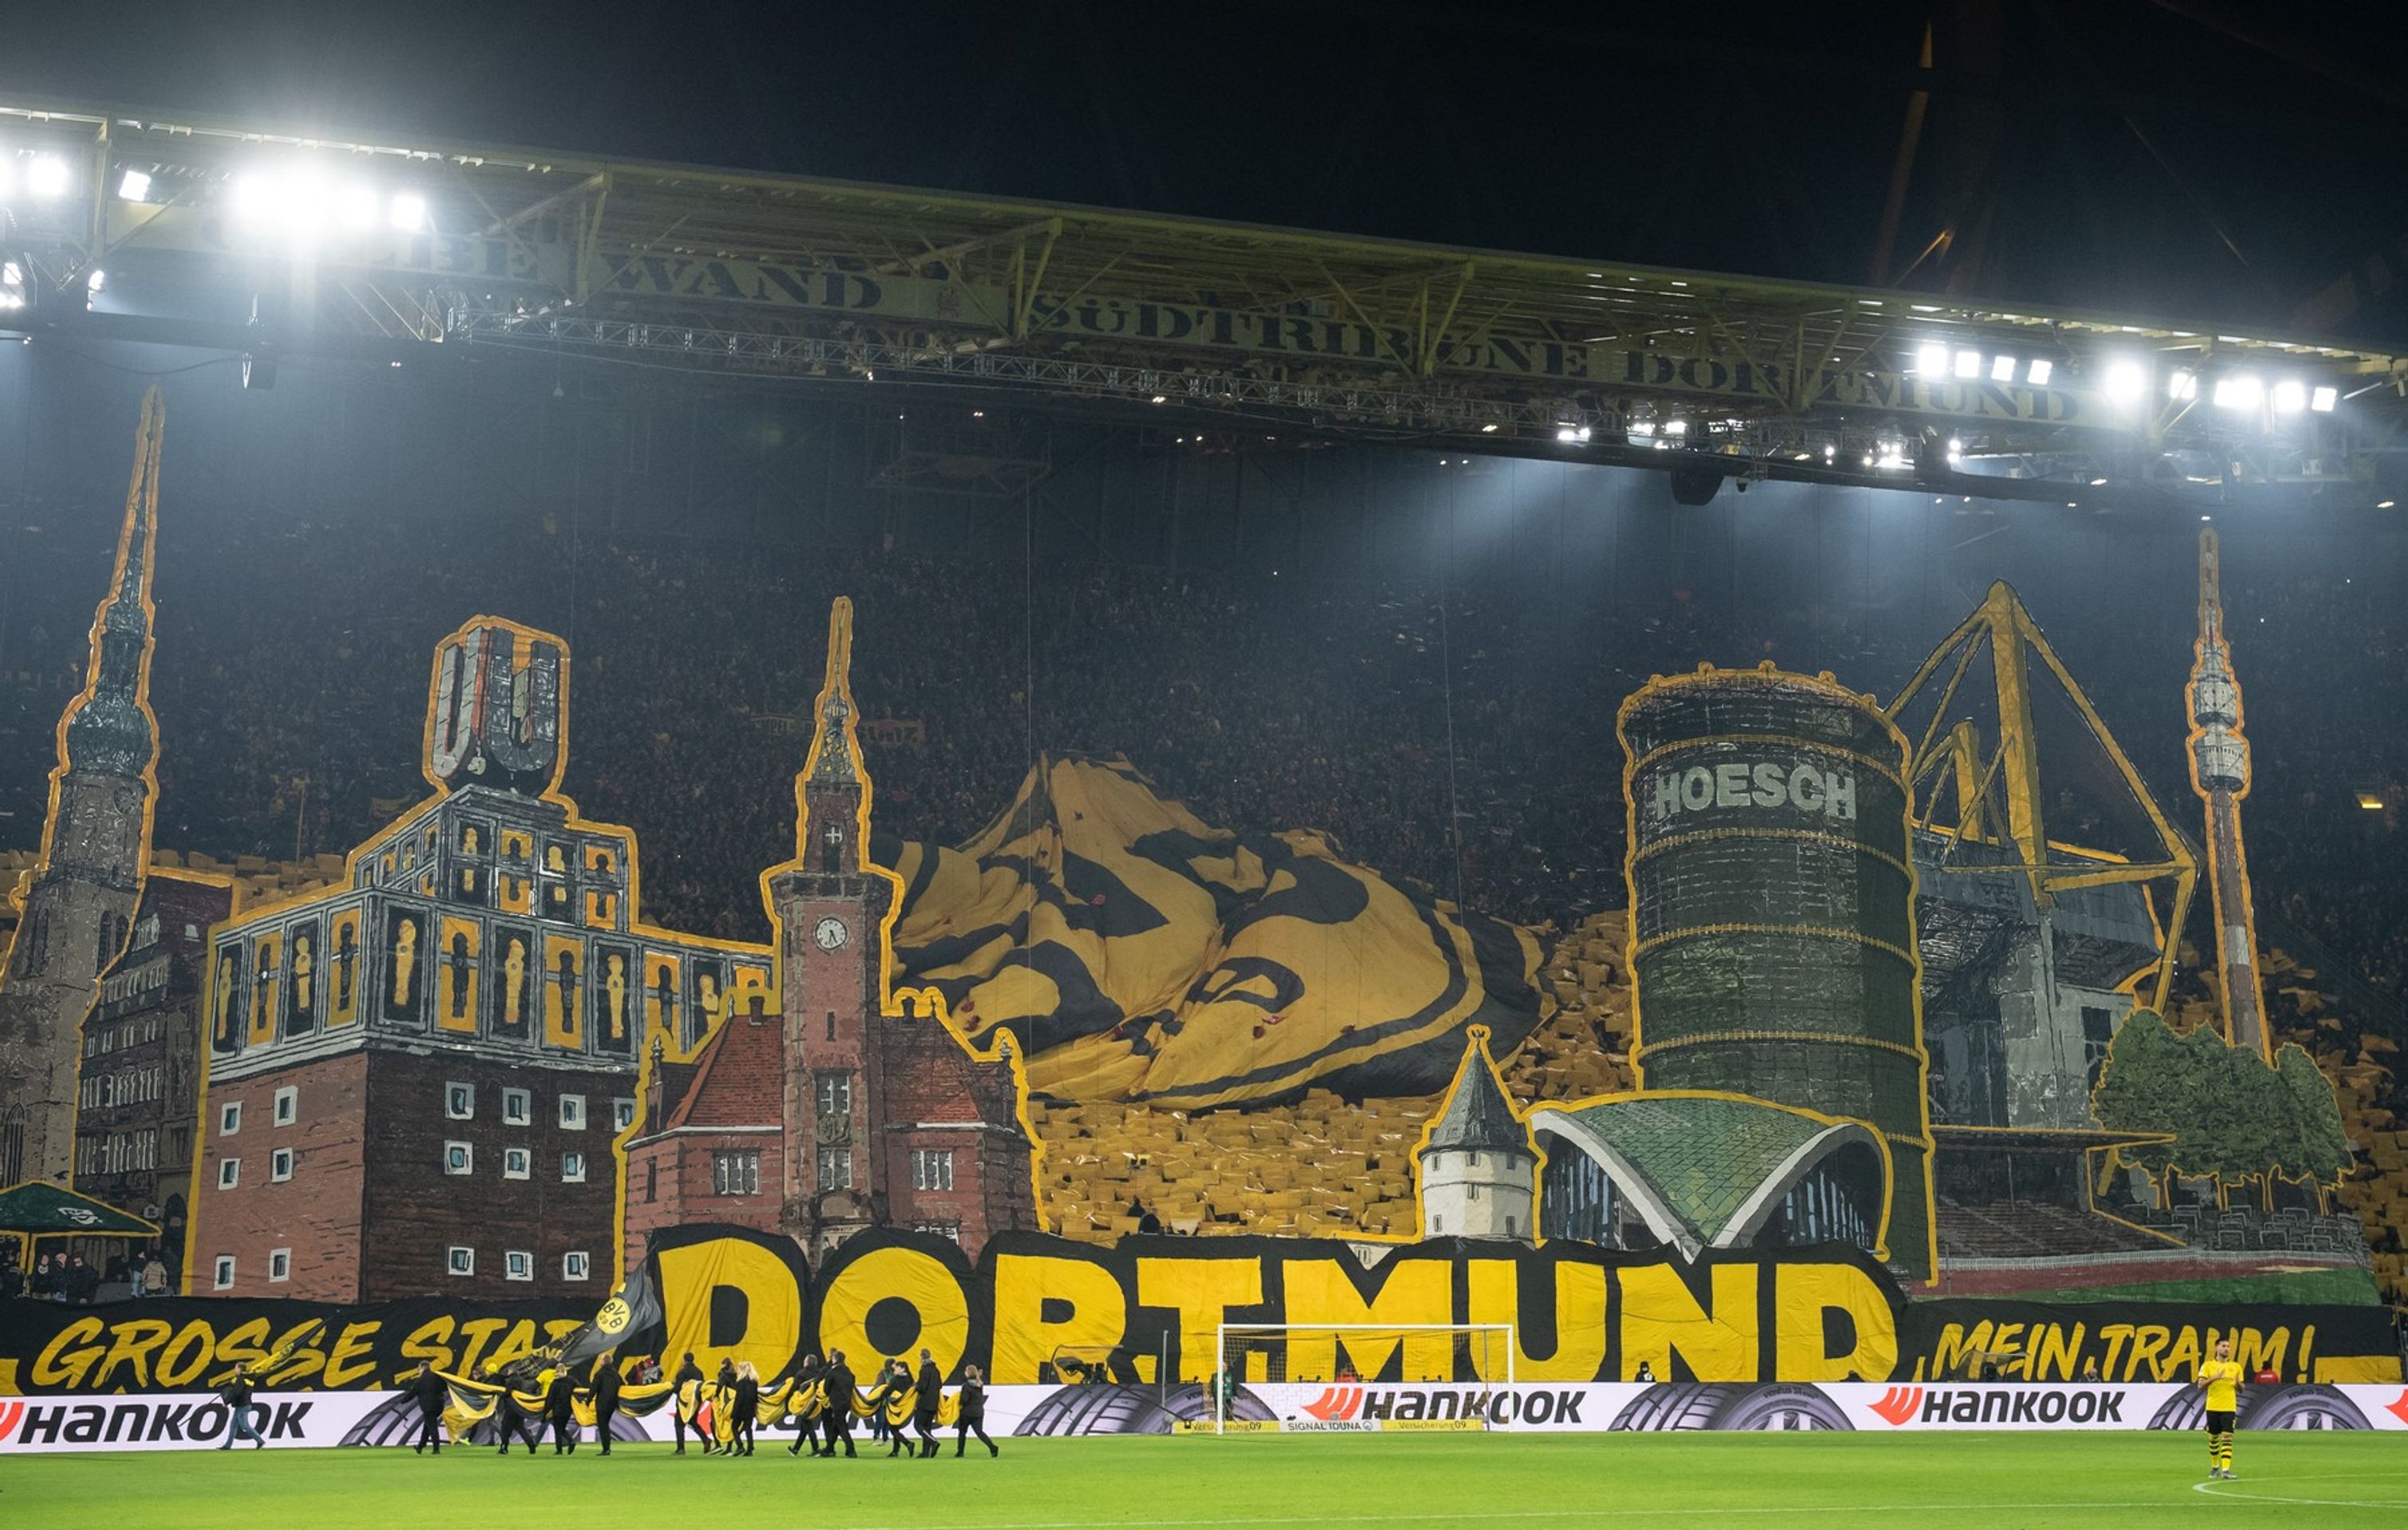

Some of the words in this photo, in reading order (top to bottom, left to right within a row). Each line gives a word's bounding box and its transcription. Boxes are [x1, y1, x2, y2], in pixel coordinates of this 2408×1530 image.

[602, 253, 882, 310] WAND
[1655, 762, 1858, 822] HOESCH
[603, 1301, 627, 1328] BVB
[31, 1316, 382, 1388] GROSSE
[1287, 1421, 1327, 1431] SIGNAL
[1329, 1421, 1361, 1431] IDUNA
